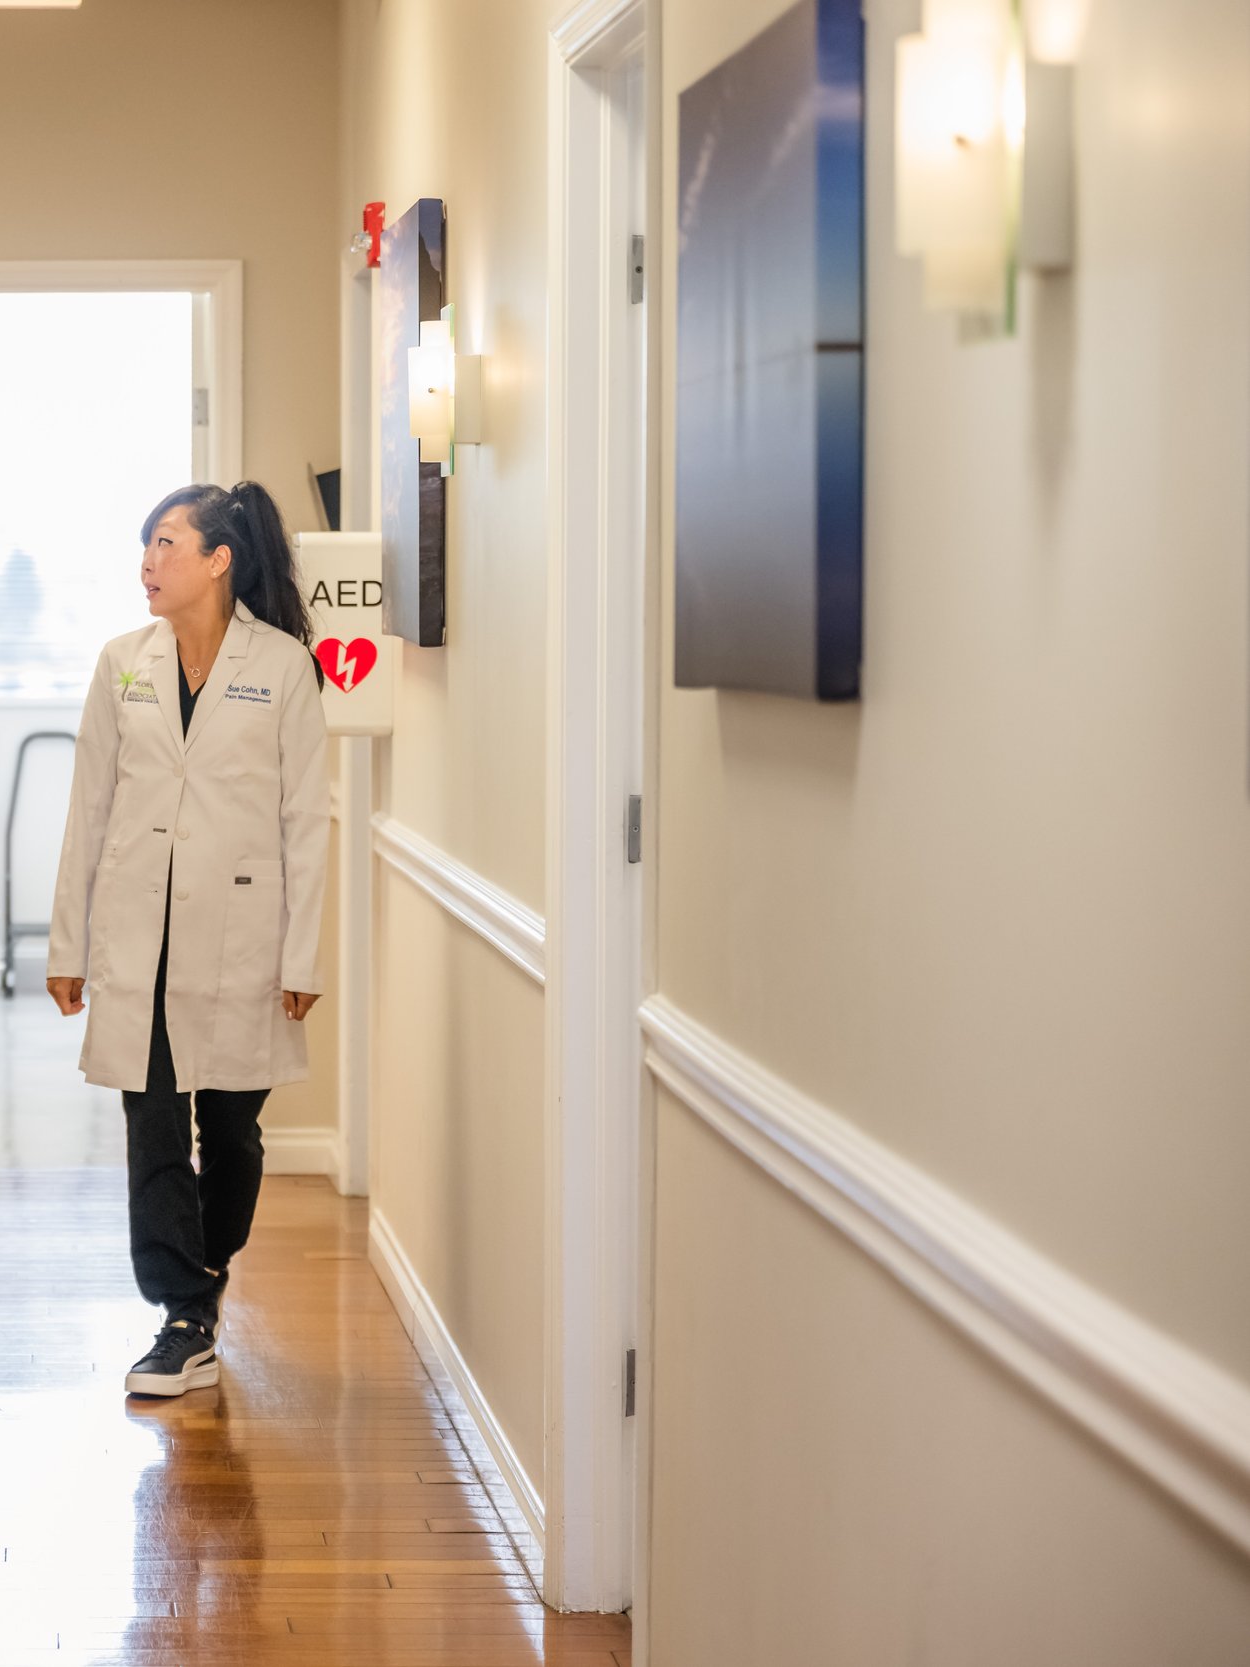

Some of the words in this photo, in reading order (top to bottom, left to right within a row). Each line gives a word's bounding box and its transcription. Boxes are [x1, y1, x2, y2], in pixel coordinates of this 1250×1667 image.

[309, 580, 382, 607] AED
[227, 684, 240, 692] Sue
[241, 686, 259, 695] Cohn,
[260, 688, 271, 696] MD
[238, 695, 271, 704] Management
